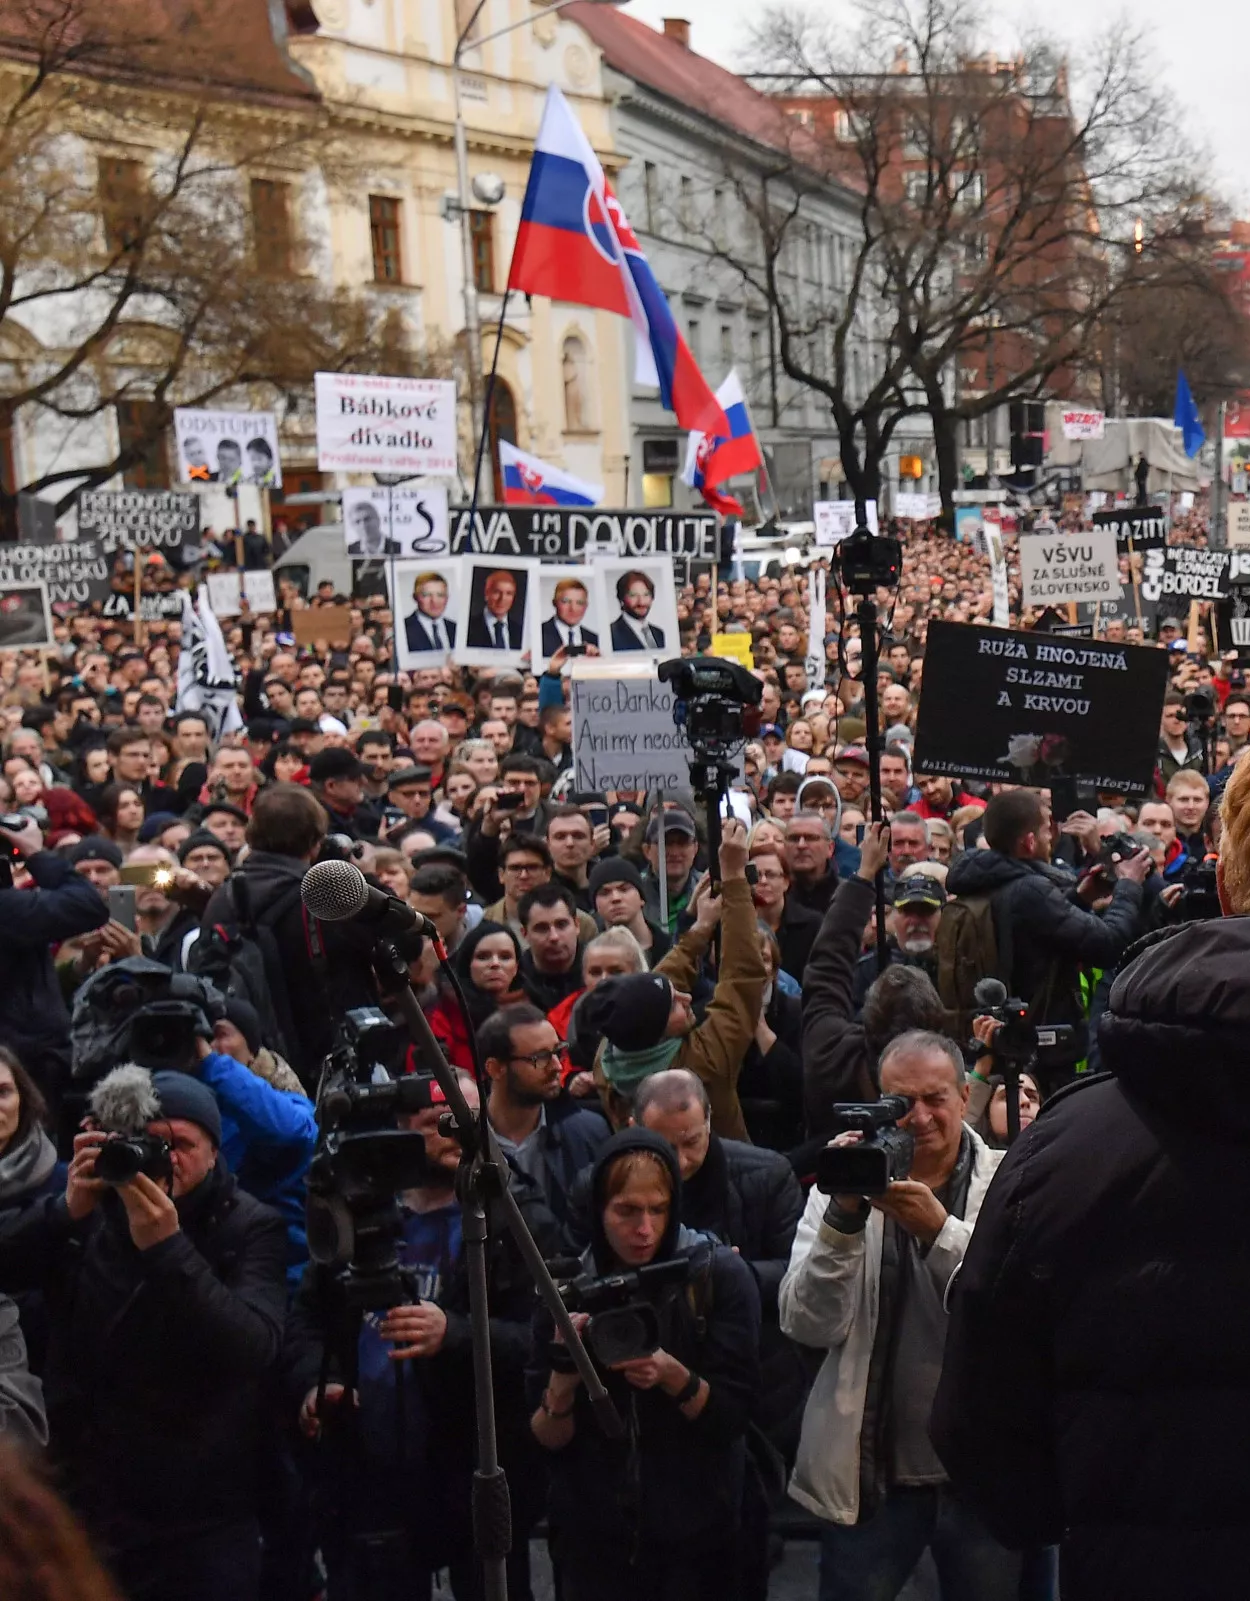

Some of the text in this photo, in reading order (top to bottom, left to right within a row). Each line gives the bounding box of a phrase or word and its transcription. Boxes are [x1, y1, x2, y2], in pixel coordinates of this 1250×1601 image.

[340, 395, 439, 420] Bábkové
[350, 426, 433, 449] divadlo
[533, 513, 562, 533] IM
[569, 511, 716, 558] DOVOĽUJE
[528, 533, 562, 554] TO
[1042, 543, 1093, 564] VŠVU
[1033, 563, 1106, 581] ZA SLUŠNÉ
[1030, 580, 1111, 597] SLOVENSKO
[977, 638, 1128, 671] RUŽA HNOJENÁ
[1006, 667, 1084, 690] SLZAMI
[617, 679, 672, 713] Danko
[996, 690, 1091, 716] A KRVOU
[578, 718, 608, 752] Ani
[611, 733, 638, 756] my
[577, 757, 679, 792] Neveríme
[921, 759, 1011, 779] #allformartina
